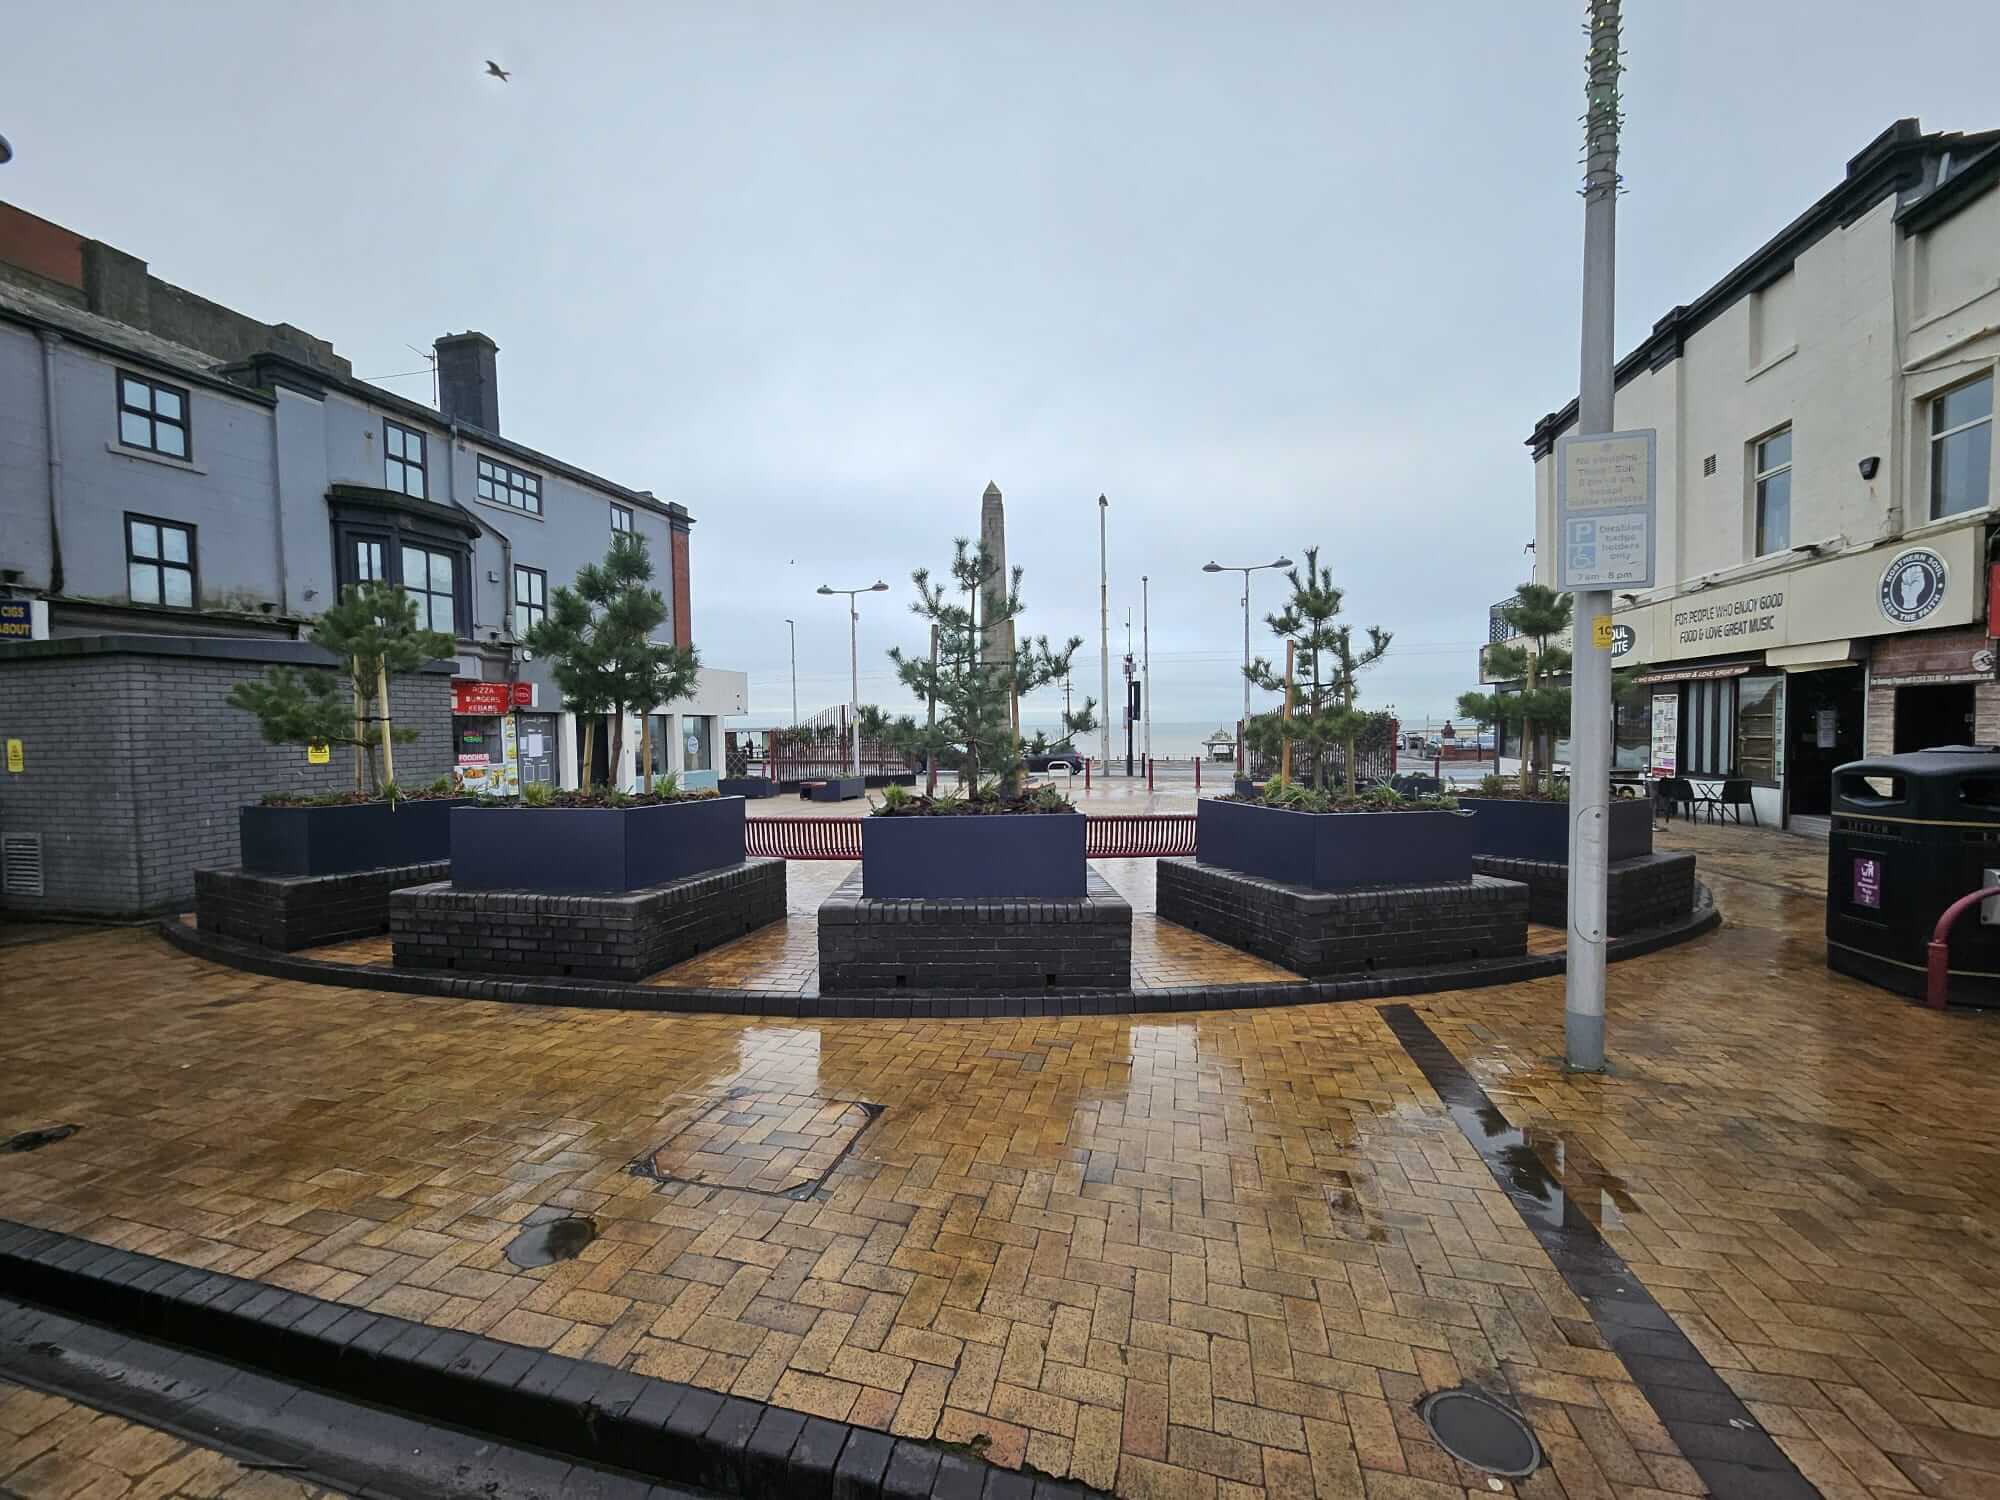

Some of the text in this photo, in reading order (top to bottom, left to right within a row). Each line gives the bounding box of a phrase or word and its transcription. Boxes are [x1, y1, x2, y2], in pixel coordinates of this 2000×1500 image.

[1602, 542, 1640, 552] holders
[1609, 551, 1632, 562] only
[1885, 553, 1943, 582] NORTHERN SOUL
[1674, 593, 1783, 626] FOR PEOPLE WHO ENJOY GOOD
[1883, 594, 1941, 621] KEEP THE FAITH
[1611, 626, 1629, 640] OUL
[1680, 628, 1698, 644] FOOD
[1705, 625, 1723, 639] LOVE
[1723, 621, 1748, 637] GREAT
[1749, 615, 1775, 632] MUSIC
